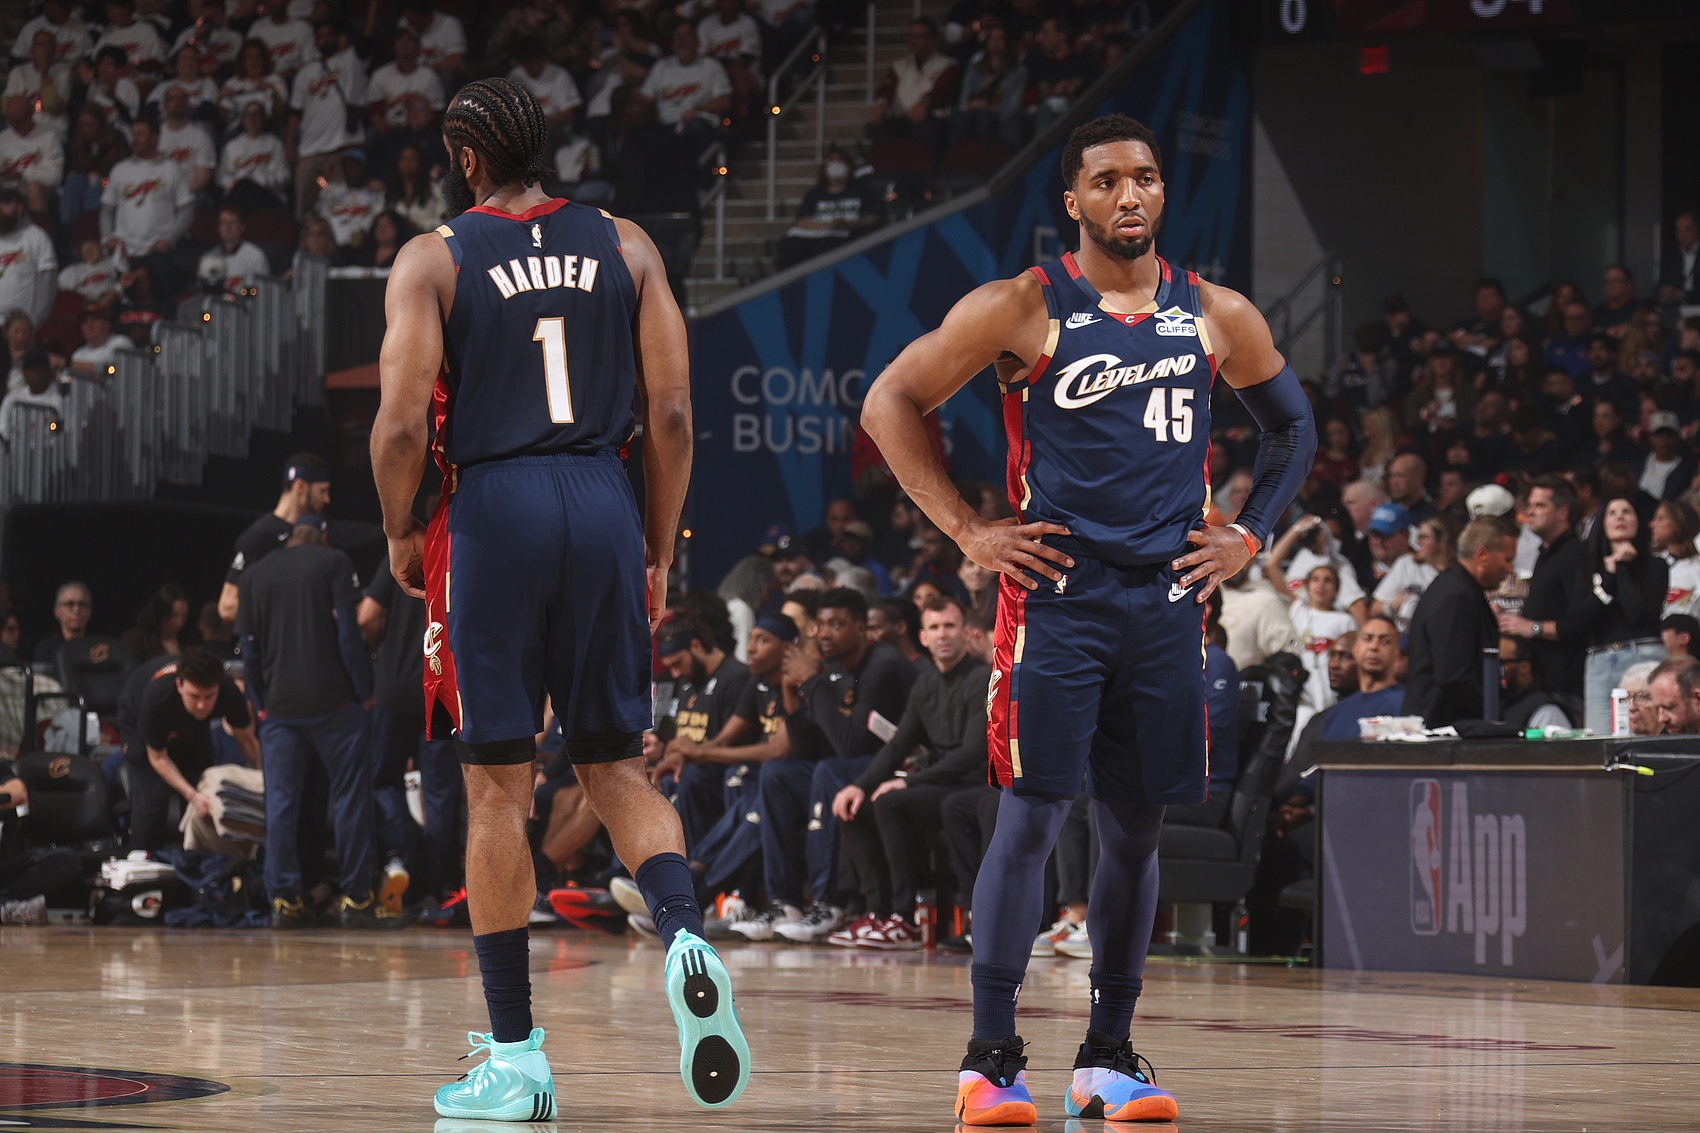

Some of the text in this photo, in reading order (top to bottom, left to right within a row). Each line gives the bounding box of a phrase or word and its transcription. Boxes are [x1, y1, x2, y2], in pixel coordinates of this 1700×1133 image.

[487, 255, 599, 300] HARDEN
[1071, 312, 1094, 323] NIKE
[1125, 315, 1135, 324] C
[1157, 325, 1196, 334] CLIFFS
[532, 317, 574, 424] 1
[731, 365, 866, 406] COMC
[1054, 353, 1197, 410] CLEVELAND
[1143, 387, 1195, 443] 45
[1447, 781, 1528, 967] App
